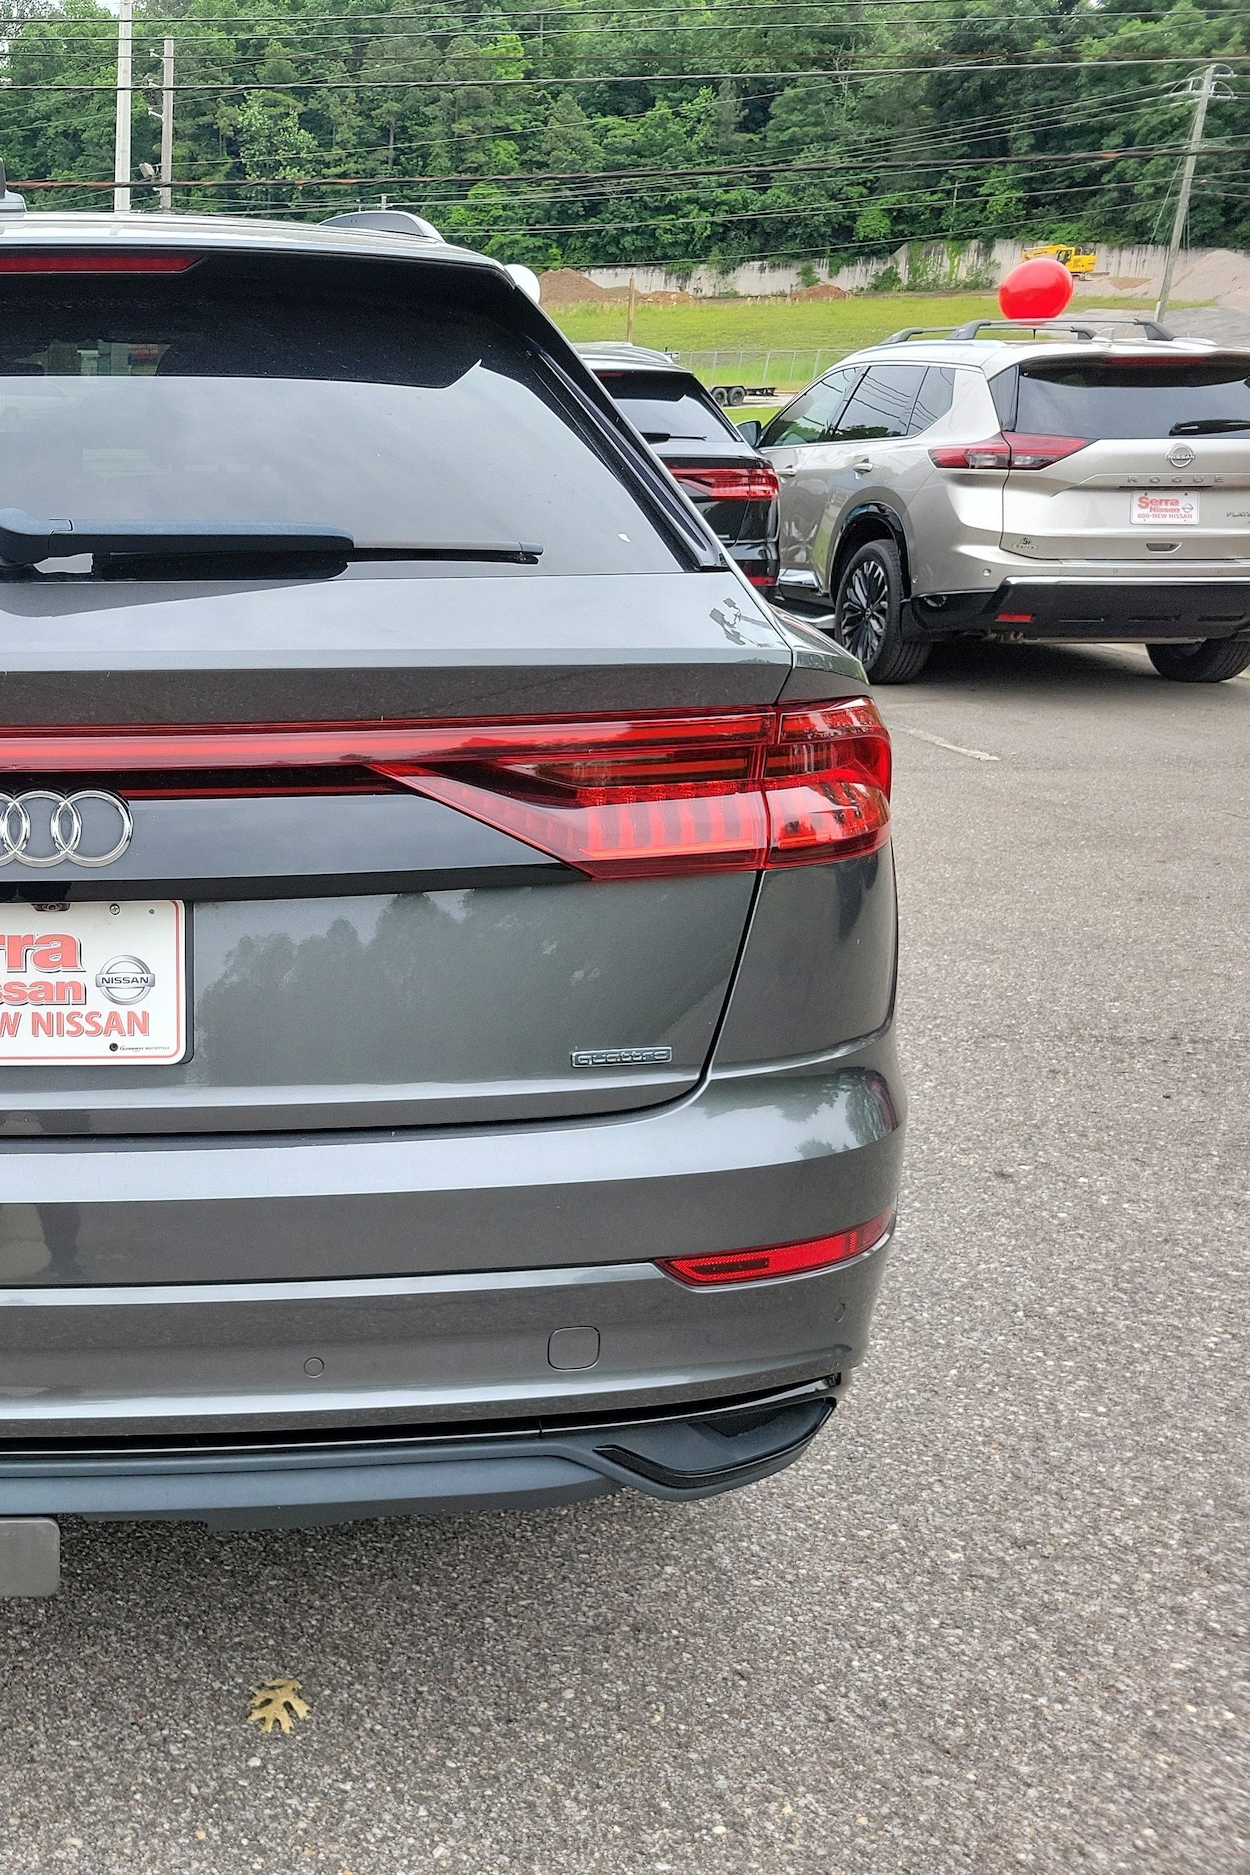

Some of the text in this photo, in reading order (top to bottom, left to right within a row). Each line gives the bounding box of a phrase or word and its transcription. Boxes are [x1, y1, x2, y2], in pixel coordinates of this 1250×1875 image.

[1127, 475, 1224, 483] ROGUE
[1137, 496, 1180, 509] Serra
[101, 976, 149, 985] NISSAN
[31, 1011, 150, 1037] NISSAN
[577, 1051, 668, 1065] quattro
